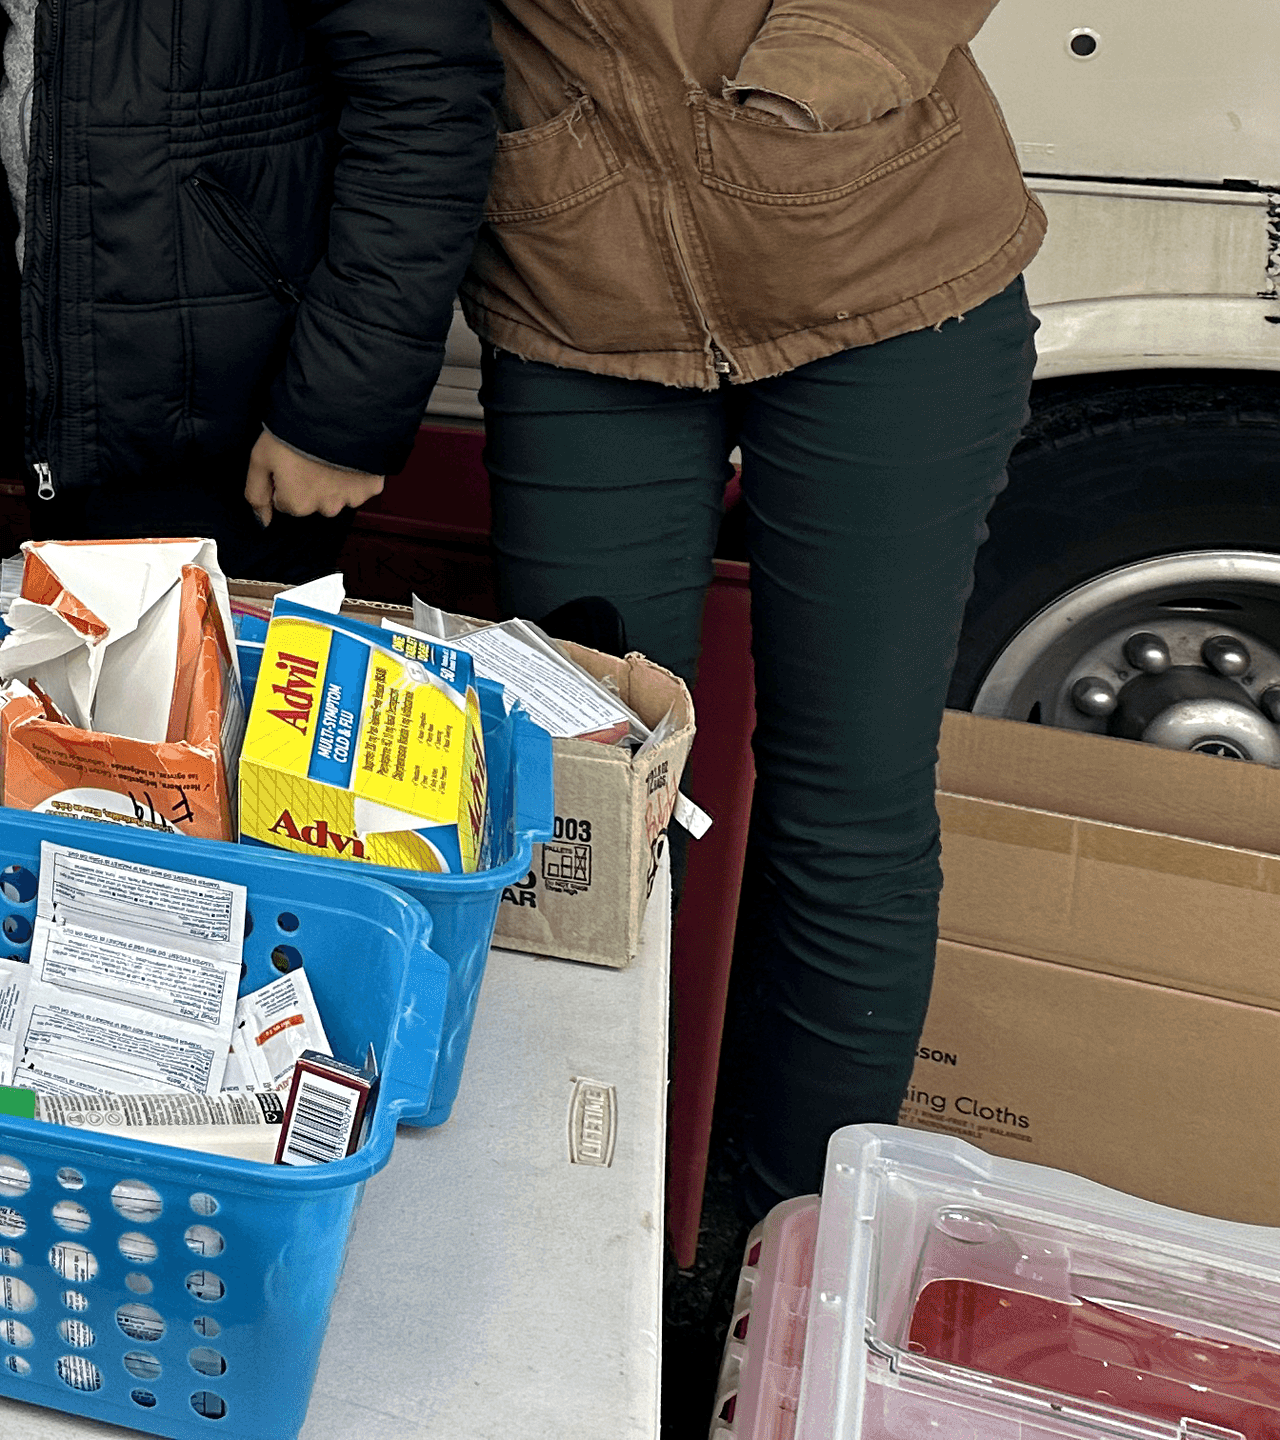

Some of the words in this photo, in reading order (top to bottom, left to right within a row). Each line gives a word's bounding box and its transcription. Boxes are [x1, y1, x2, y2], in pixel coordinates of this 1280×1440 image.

[392, 635, 406, 652] ONE
[440, 667, 455, 682] 50
[266, 651, 319, 736] Advil
[317, 683, 343, 759] MULTI-SYMPTOM
[339, 724, 352, 738] &
[340, 710, 355, 731] FLU
[332, 734, 350, 764] COLD
[268, 808, 371, 861] Advi
[955, 1096, 1030, 1130] Cloths
